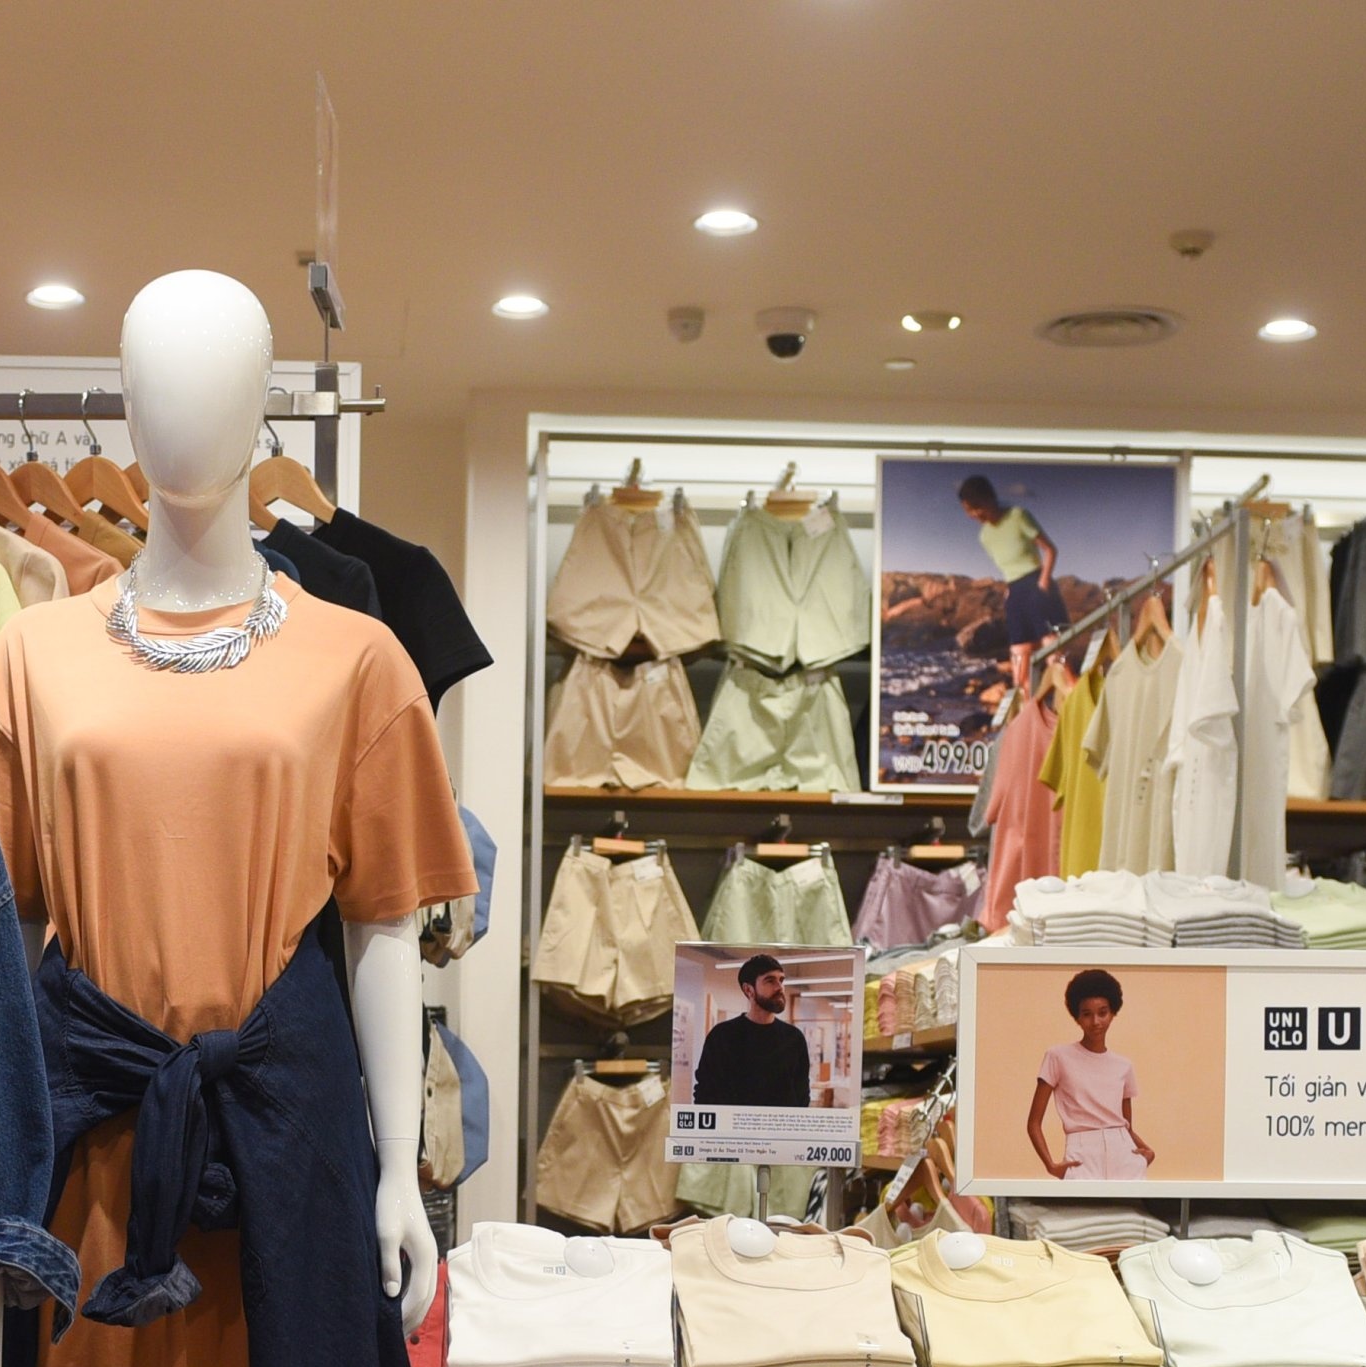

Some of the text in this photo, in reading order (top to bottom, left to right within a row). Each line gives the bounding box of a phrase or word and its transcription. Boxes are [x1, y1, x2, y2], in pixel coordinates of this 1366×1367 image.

[56, 431, 67, 445] A
[923, 743, 987, 770] 499.0
[1328, 1012, 1351, 1046] U
[1264, 1074, 1295, 1097] Tối
[1305, 1075, 1347, 1103] giản
[1266, 1115, 1315, 1137] 100%
[807, 1146, 852, 1162] 249.000
